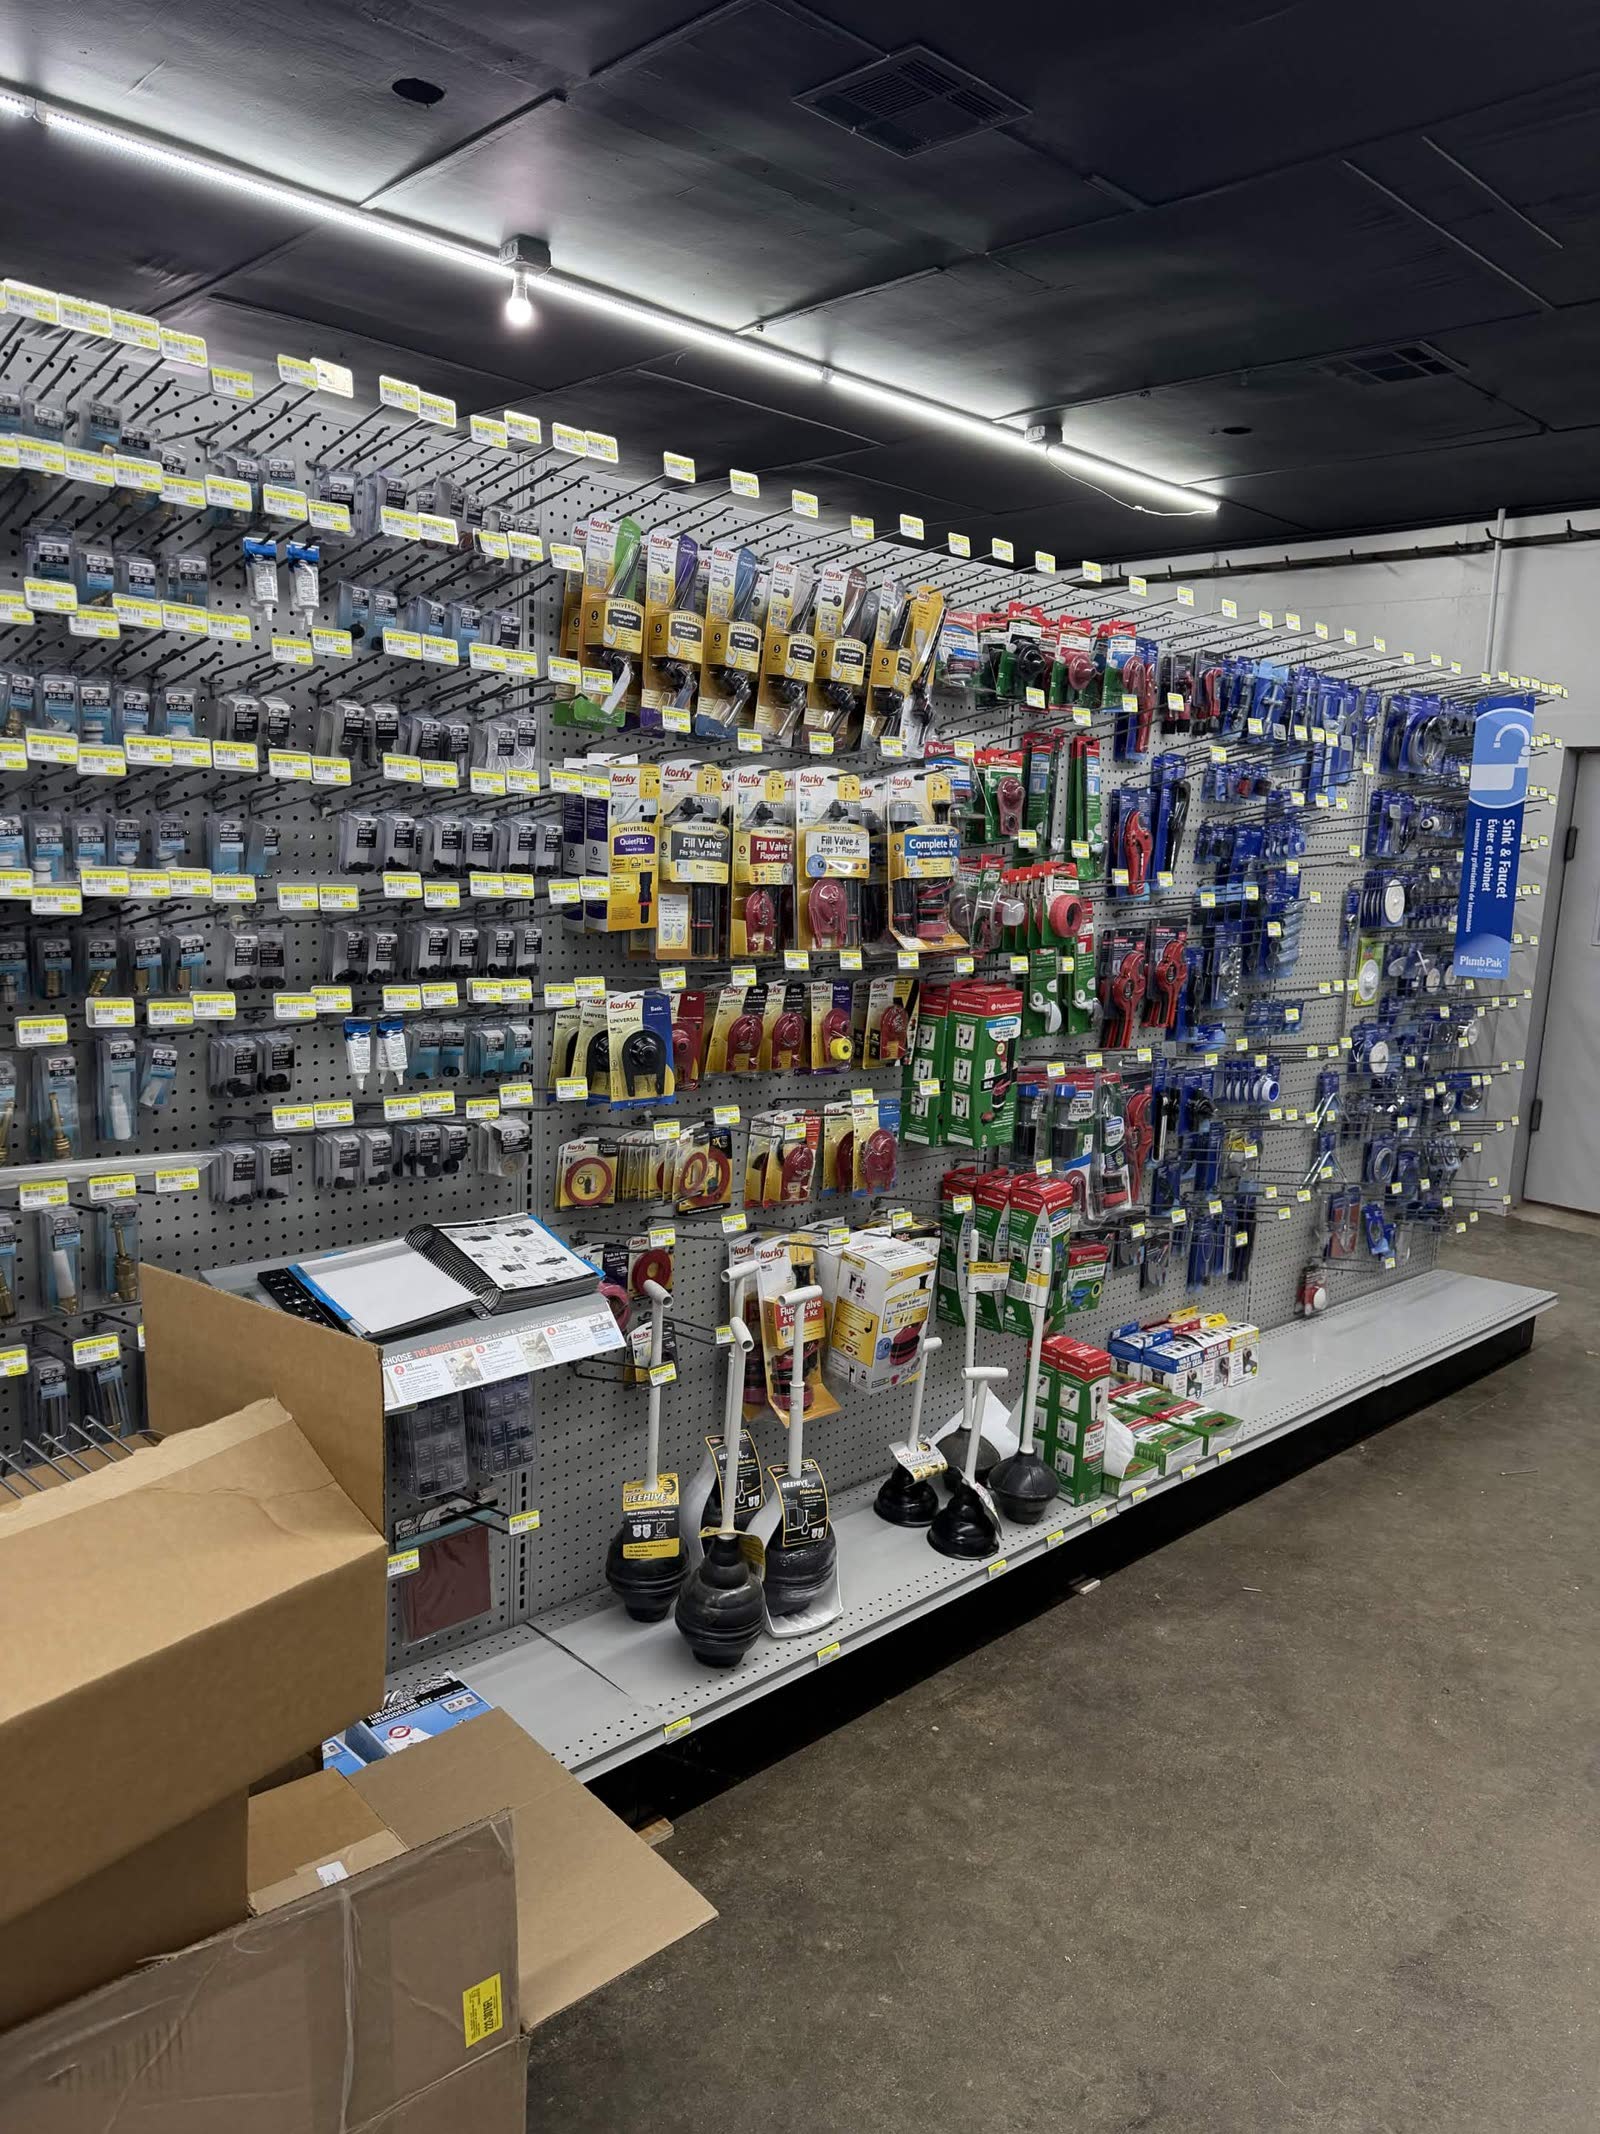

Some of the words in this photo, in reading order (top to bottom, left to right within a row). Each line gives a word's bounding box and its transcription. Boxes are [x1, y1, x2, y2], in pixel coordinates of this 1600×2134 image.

[590, 518, 614, 532] korky
[650, 534, 673, 548] korky
[713, 547, 736, 560] korky
[824, 569, 844, 580] korky
[610, 602, 640, 614] UNIVERSAL
[673, 615, 704, 624] UNIVERSAL
[732, 625, 760, 634] UNIVERSAL
[612, 773, 636, 785] korky
[664, 766, 693, 780] korky
[800, 772, 824, 785] korky
[738, 773, 762, 786] korky
[892, 776, 912, 787] korky
[1472, 818, 1482, 851] Lavamanos
[1486, 818, 1499, 842] Évier
[1501, 818, 1516, 844] Sink
[682, 838, 696, 848] Fill
[697, 838, 722, 850] Valve
[821, 835, 832, 845] Fill
[834, 835, 854, 846] Valve
[909, 839, 948, 851] Complete
[949, 839, 958, 849] Kit
[756, 842, 767, 852] Fill
[769, 842, 788, 852] Valve
[816, 846, 834, 854] Large
[842, 847, 862, 855] Flapper
[1485, 845, 1495, 855] et
[1500, 848, 1512, 858] &
[706, 850, 722, 858] Toilets
[760, 852, 780, 861] Flapper
[1481, 857, 1494, 893] robinet
[1496, 860, 1511, 899] Faucet
[1465, 902, 1474, 933] lavamanos
[610, 1001, 636, 1011] korky
[610, 1016, 640, 1024] UNIVERSAL
[760, 1248, 784, 1260] korky
[780, 1306, 796, 1317] Flus
[805, 1300, 821, 1310] alve
[382, 1352, 414, 1367] CHOOSE
[413, 1349, 430, 1359] THE
[429, 1344, 452, 1355] RIGHT
[454, 1338, 475, 1349] STEM
[782, 1479, 808, 1488] BEEHIVE
[626, 1493, 666, 1503] BEEHIVE
[367, 1698, 417, 1721] TUB/SHOWER
[371, 1703, 421, 1726] REMODELING
[420, 1697, 433, 1707] KIT
